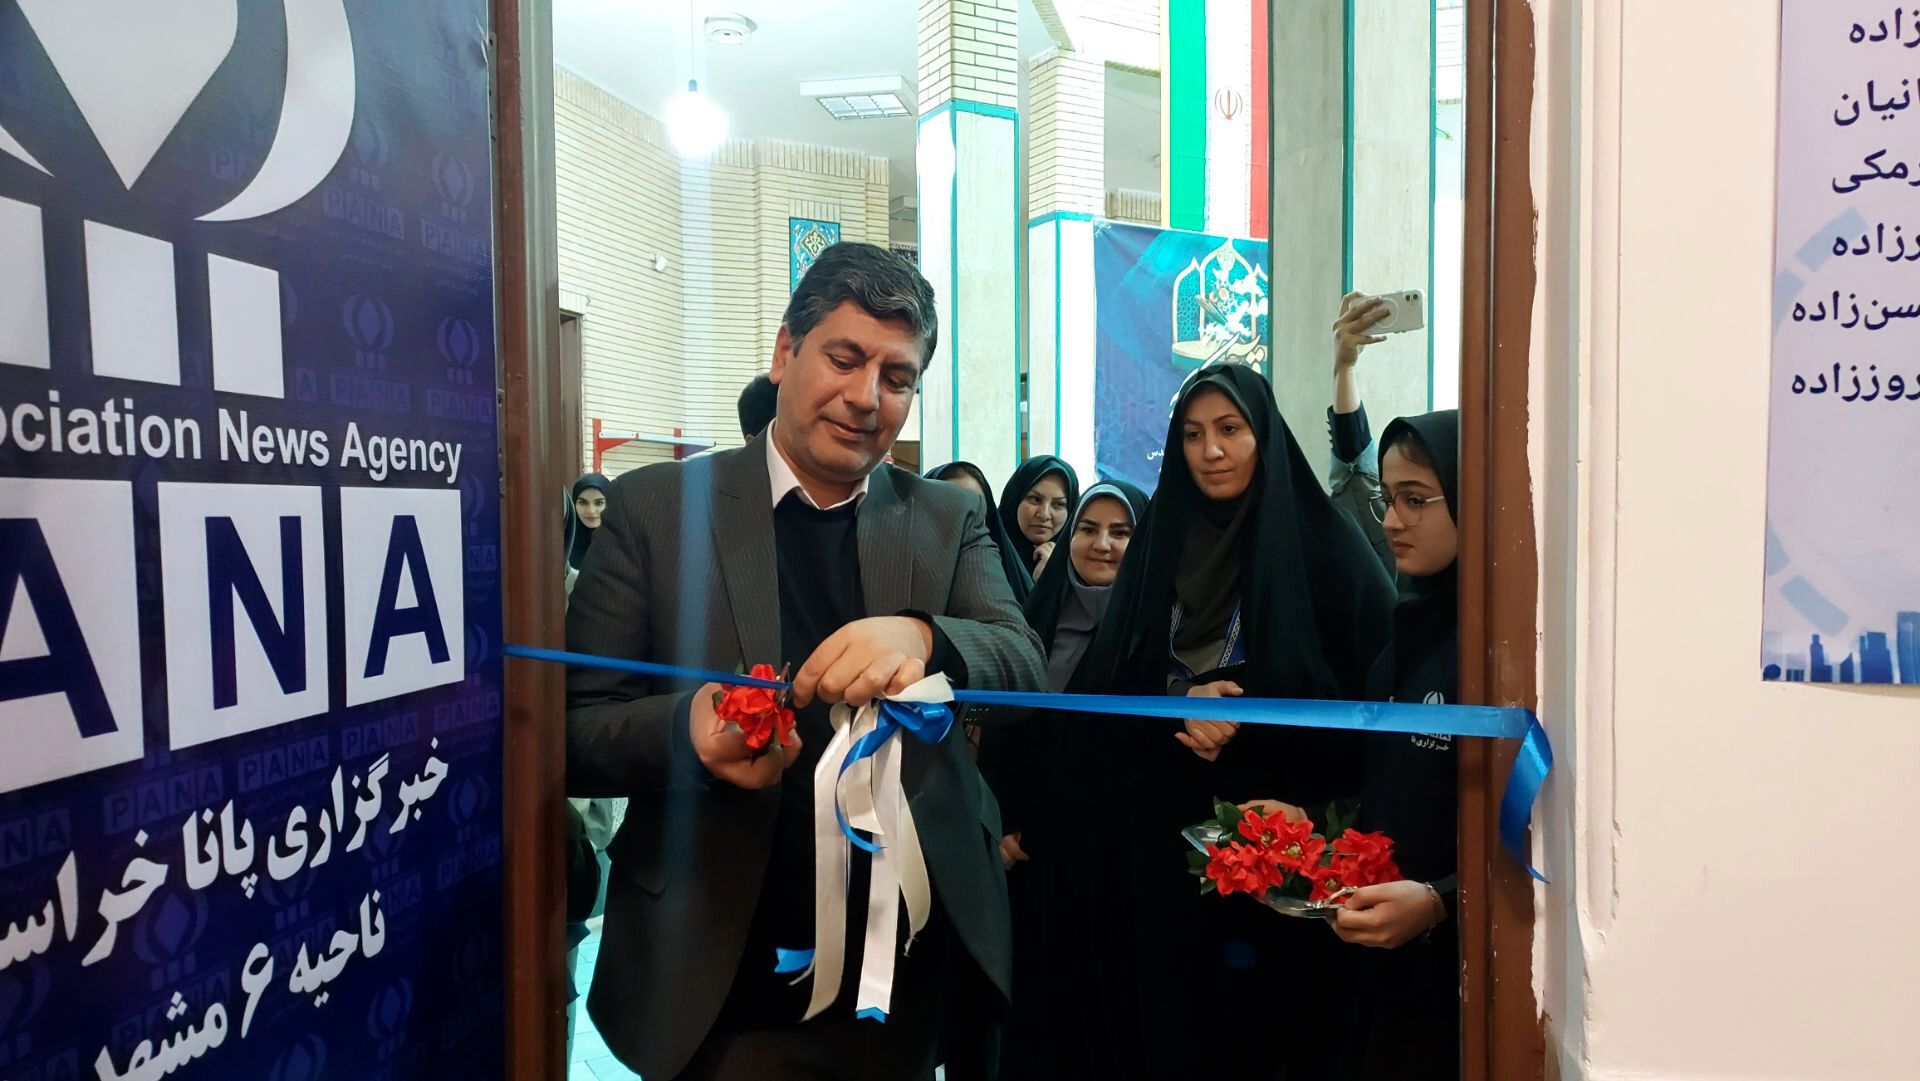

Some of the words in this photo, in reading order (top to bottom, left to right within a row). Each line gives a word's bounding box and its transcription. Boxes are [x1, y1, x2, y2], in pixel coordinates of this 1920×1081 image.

[0, 389, 202, 460] ciation
[218, 407, 330, 467] News
[340, 421, 462, 484] Agency
[0, 515, 451, 739] ANA
[343, 713, 418, 759] PANA
[434, 692, 499, 732] PANA
[105, 767, 223, 834] PANA
[239, 737, 329, 792] PANA
[268, 737, 449, 881] خبرگزاری
[182, 799, 259, 900] پانا
[241, 941, 274, 1039] ۶
[289, 889, 386, 1008] ناحیه
